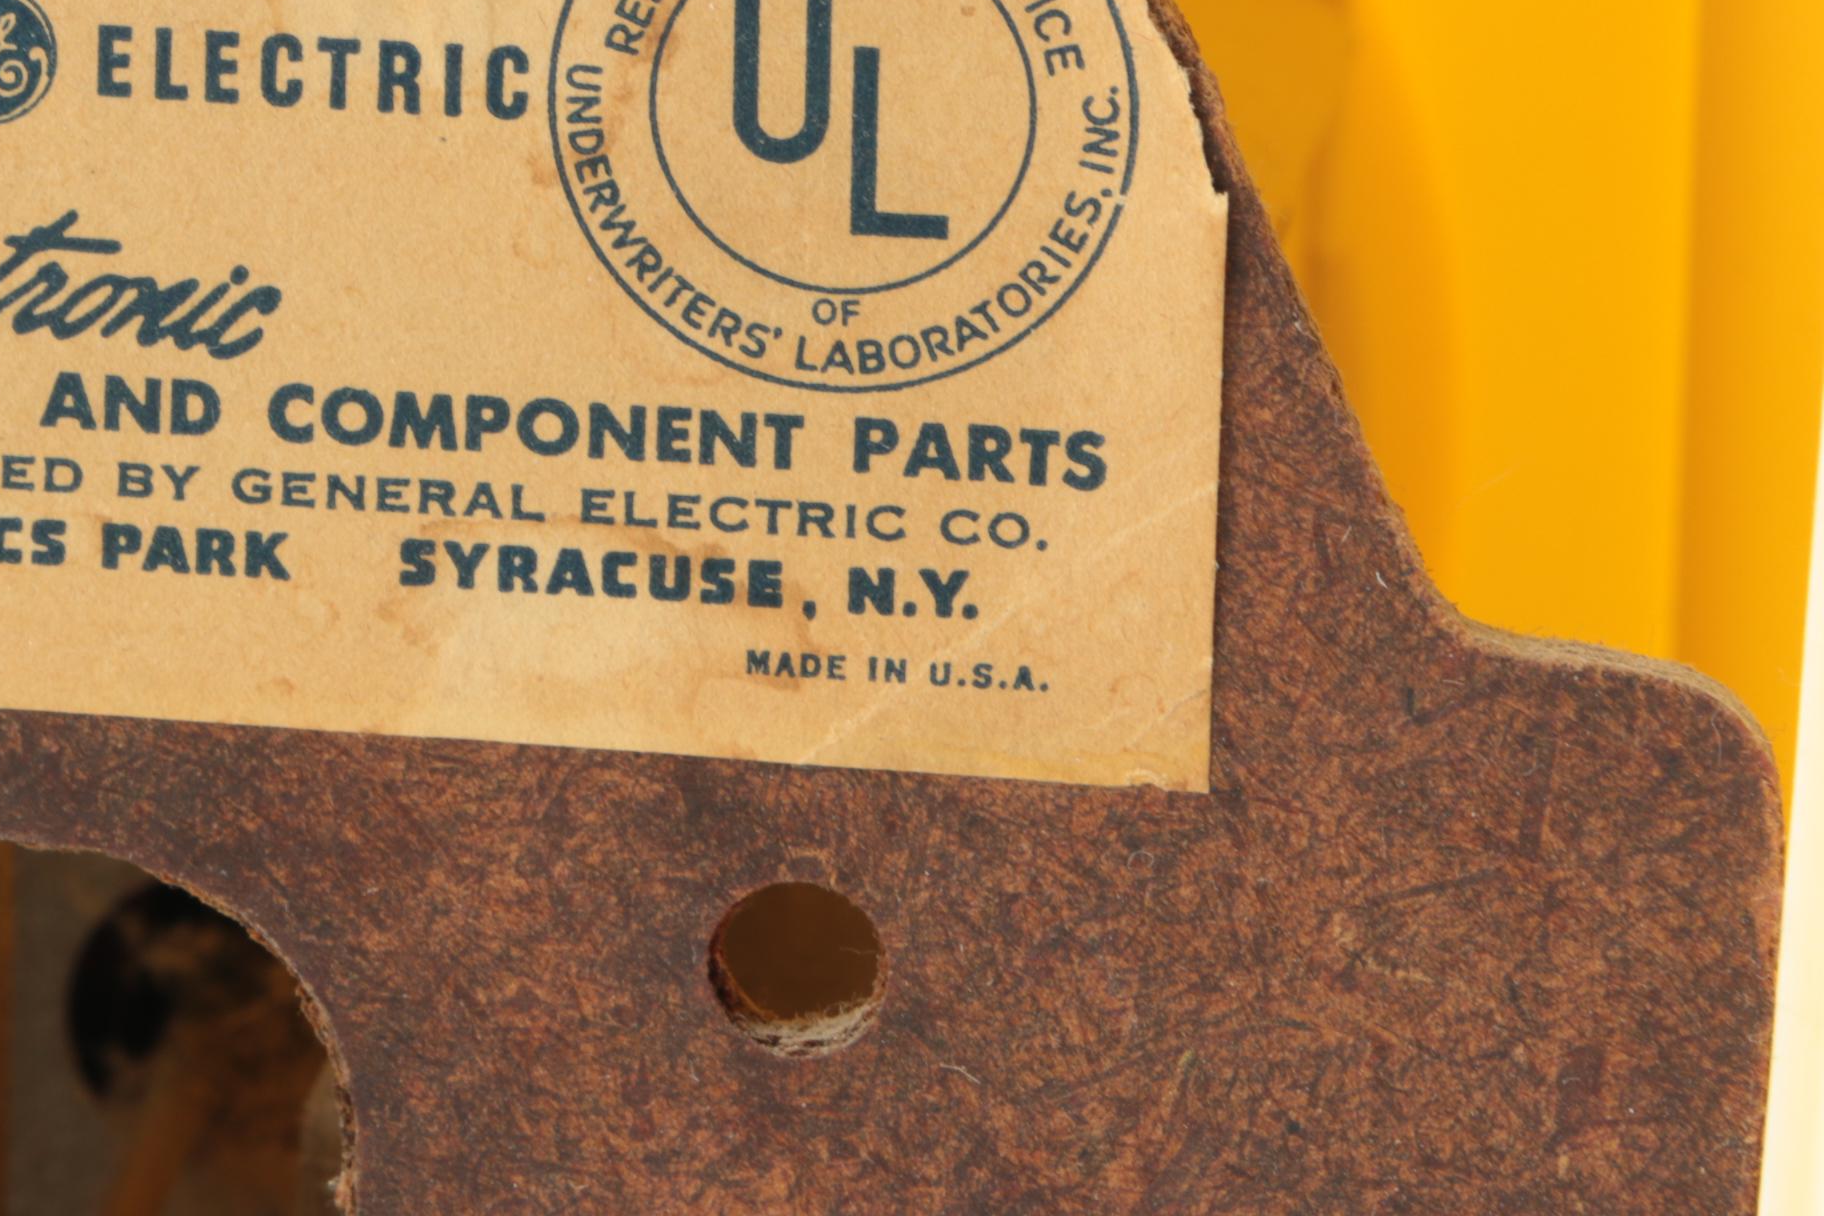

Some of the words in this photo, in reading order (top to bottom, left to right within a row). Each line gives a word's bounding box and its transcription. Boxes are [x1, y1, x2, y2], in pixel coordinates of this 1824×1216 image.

[97, 23, 530, 121] ELECTRIC
[565, 64, 782, 360] UNDERWRITERS'
[794, 187, 1114, 376] LABORATORIES,
[1078, 84, 1121, 175] INC.
[811, 298, 859, 326] OF
[41, 370, 222, 436] AND
[266, 381, 806, 472] COMPONENT
[853, 415, 1107, 491] PARTS
[118, 461, 199, 501] BY
[232, 467, 546, 522] GENERAL
[580, 487, 906, 542] ELECTRIC
[940, 508, 1047, 551] CO.
[102, 522, 290, 581] PARK
[847, 566, 978, 620] N.Y.
[746, 650, 845, 679] MADE
[869, 655, 907, 683] IN
[928, 660, 1049, 693] U.S.A.
